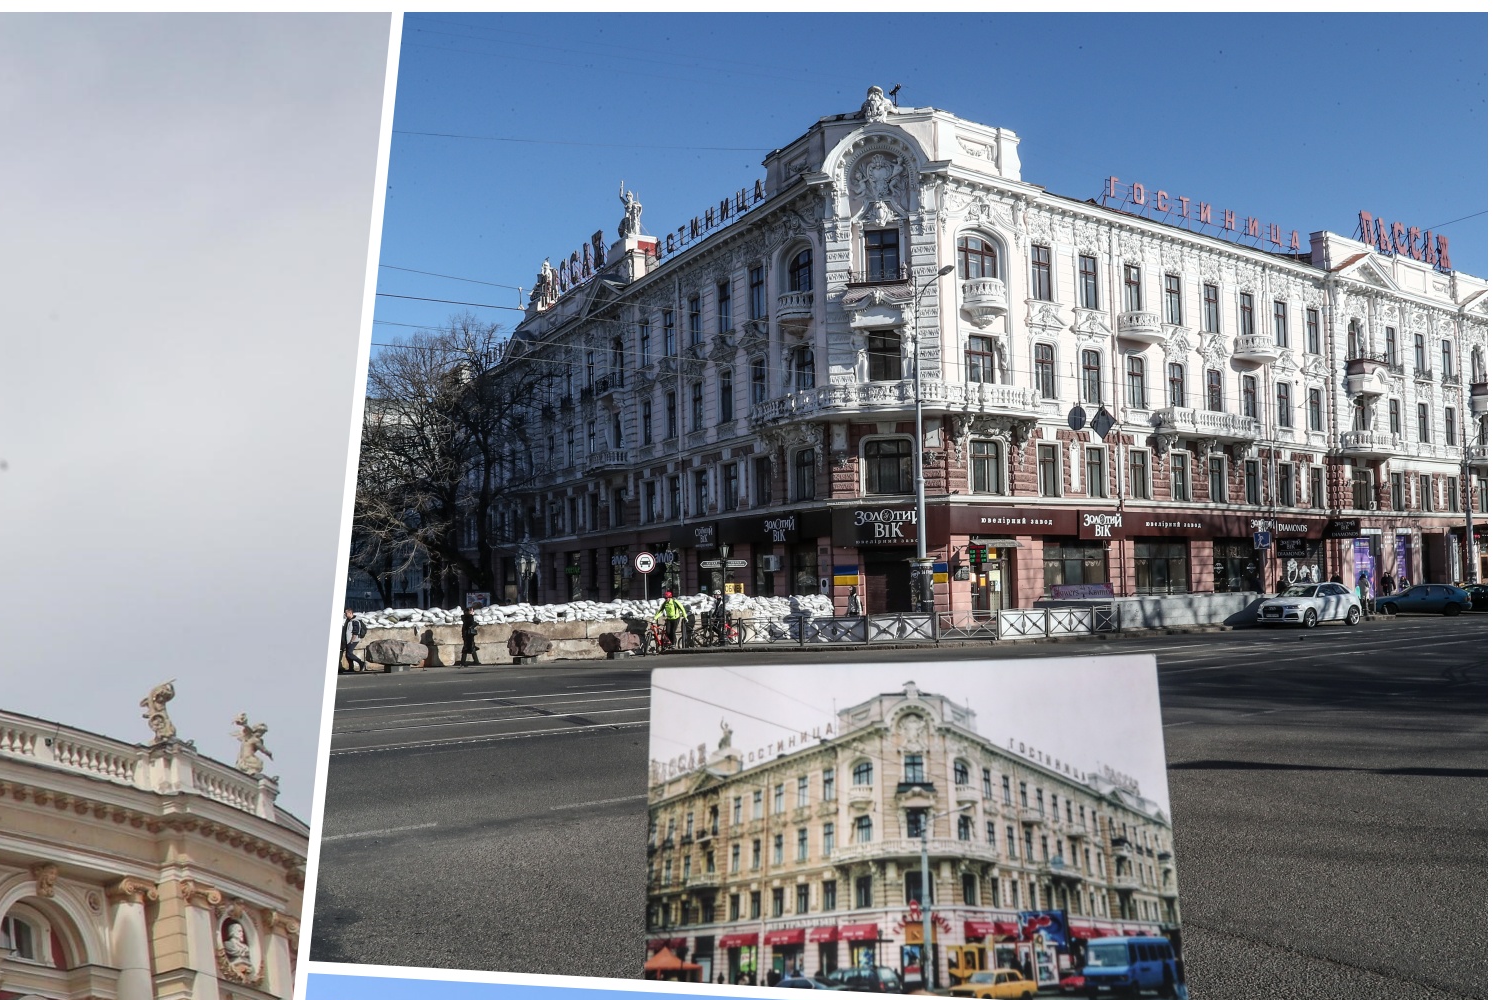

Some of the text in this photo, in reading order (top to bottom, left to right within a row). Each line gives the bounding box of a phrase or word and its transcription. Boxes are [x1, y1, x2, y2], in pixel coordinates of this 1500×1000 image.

[1109, 176, 1300, 250] ГОСТИНИЦА
[1359, 209, 1450, 268] ПАССАЖ
[981, 516, 1026, 525] ювелірний
[1278, 523, 1308, 533] DIAMONDS
[740, 723, 833, 764] ГОСТИНИЦА
